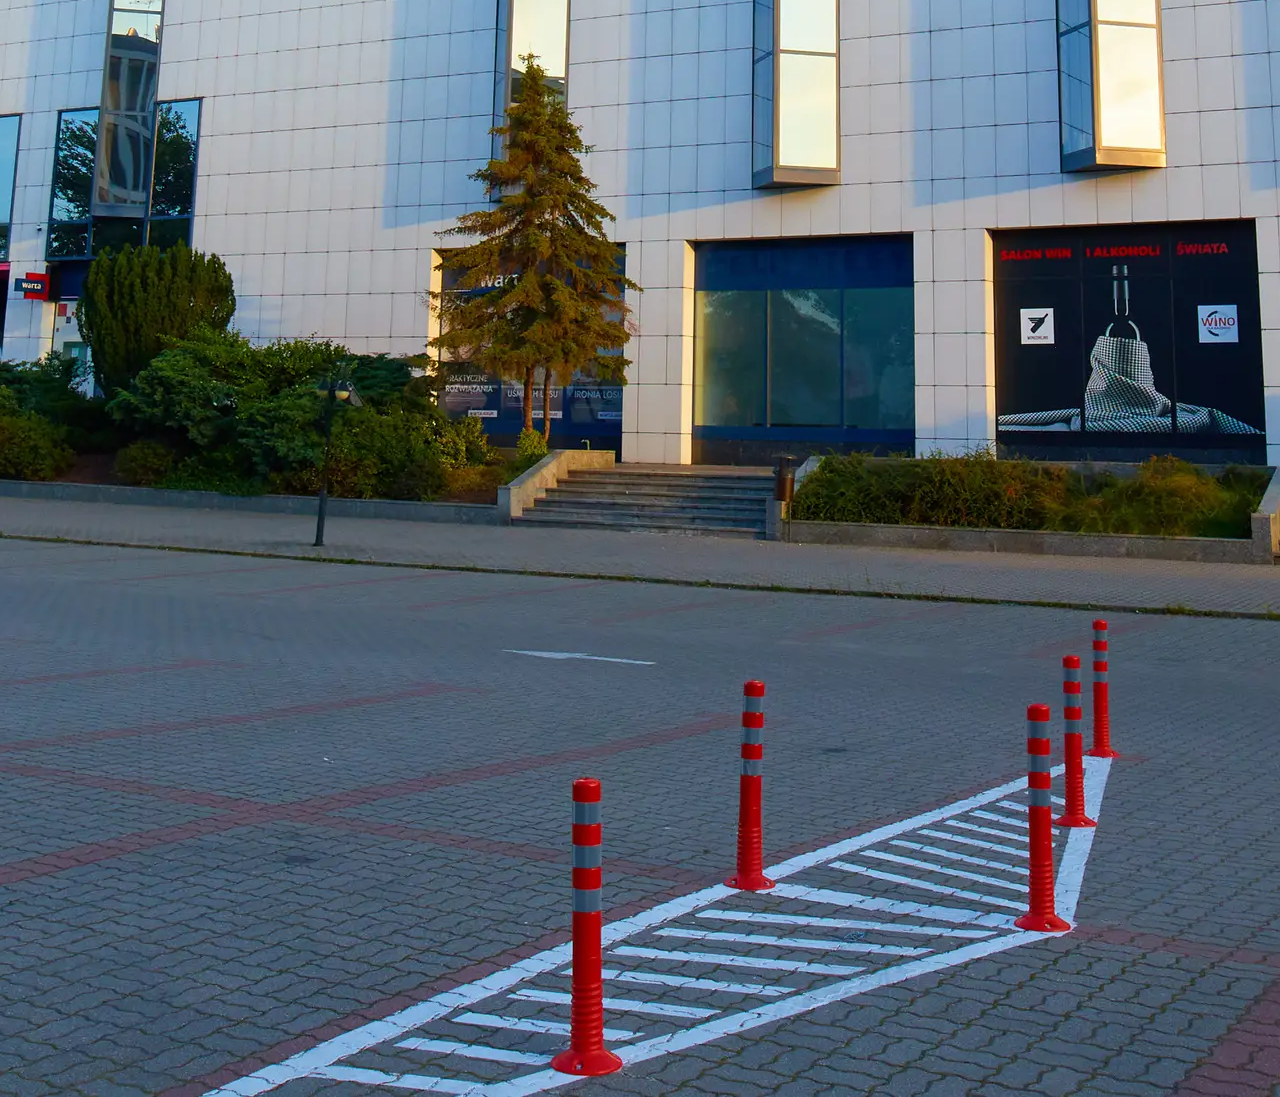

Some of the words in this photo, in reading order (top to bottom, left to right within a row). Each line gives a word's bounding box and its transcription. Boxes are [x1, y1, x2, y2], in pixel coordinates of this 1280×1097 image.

[1000, 249, 1042, 260] SALON
[1045, 247, 1071, 259] WIN
[1093, 244, 1160, 257] ALKOHOLI
[1176, 241, 1228, 256] ŚWIATA
[22, 282, 42, 290] warta
[1201, 314, 1236, 327] WINO
[446, 374, 489, 383] RAKTYCZNE
[540, 389, 558, 398] LSU
[574, 390, 602, 399] IRONIA
